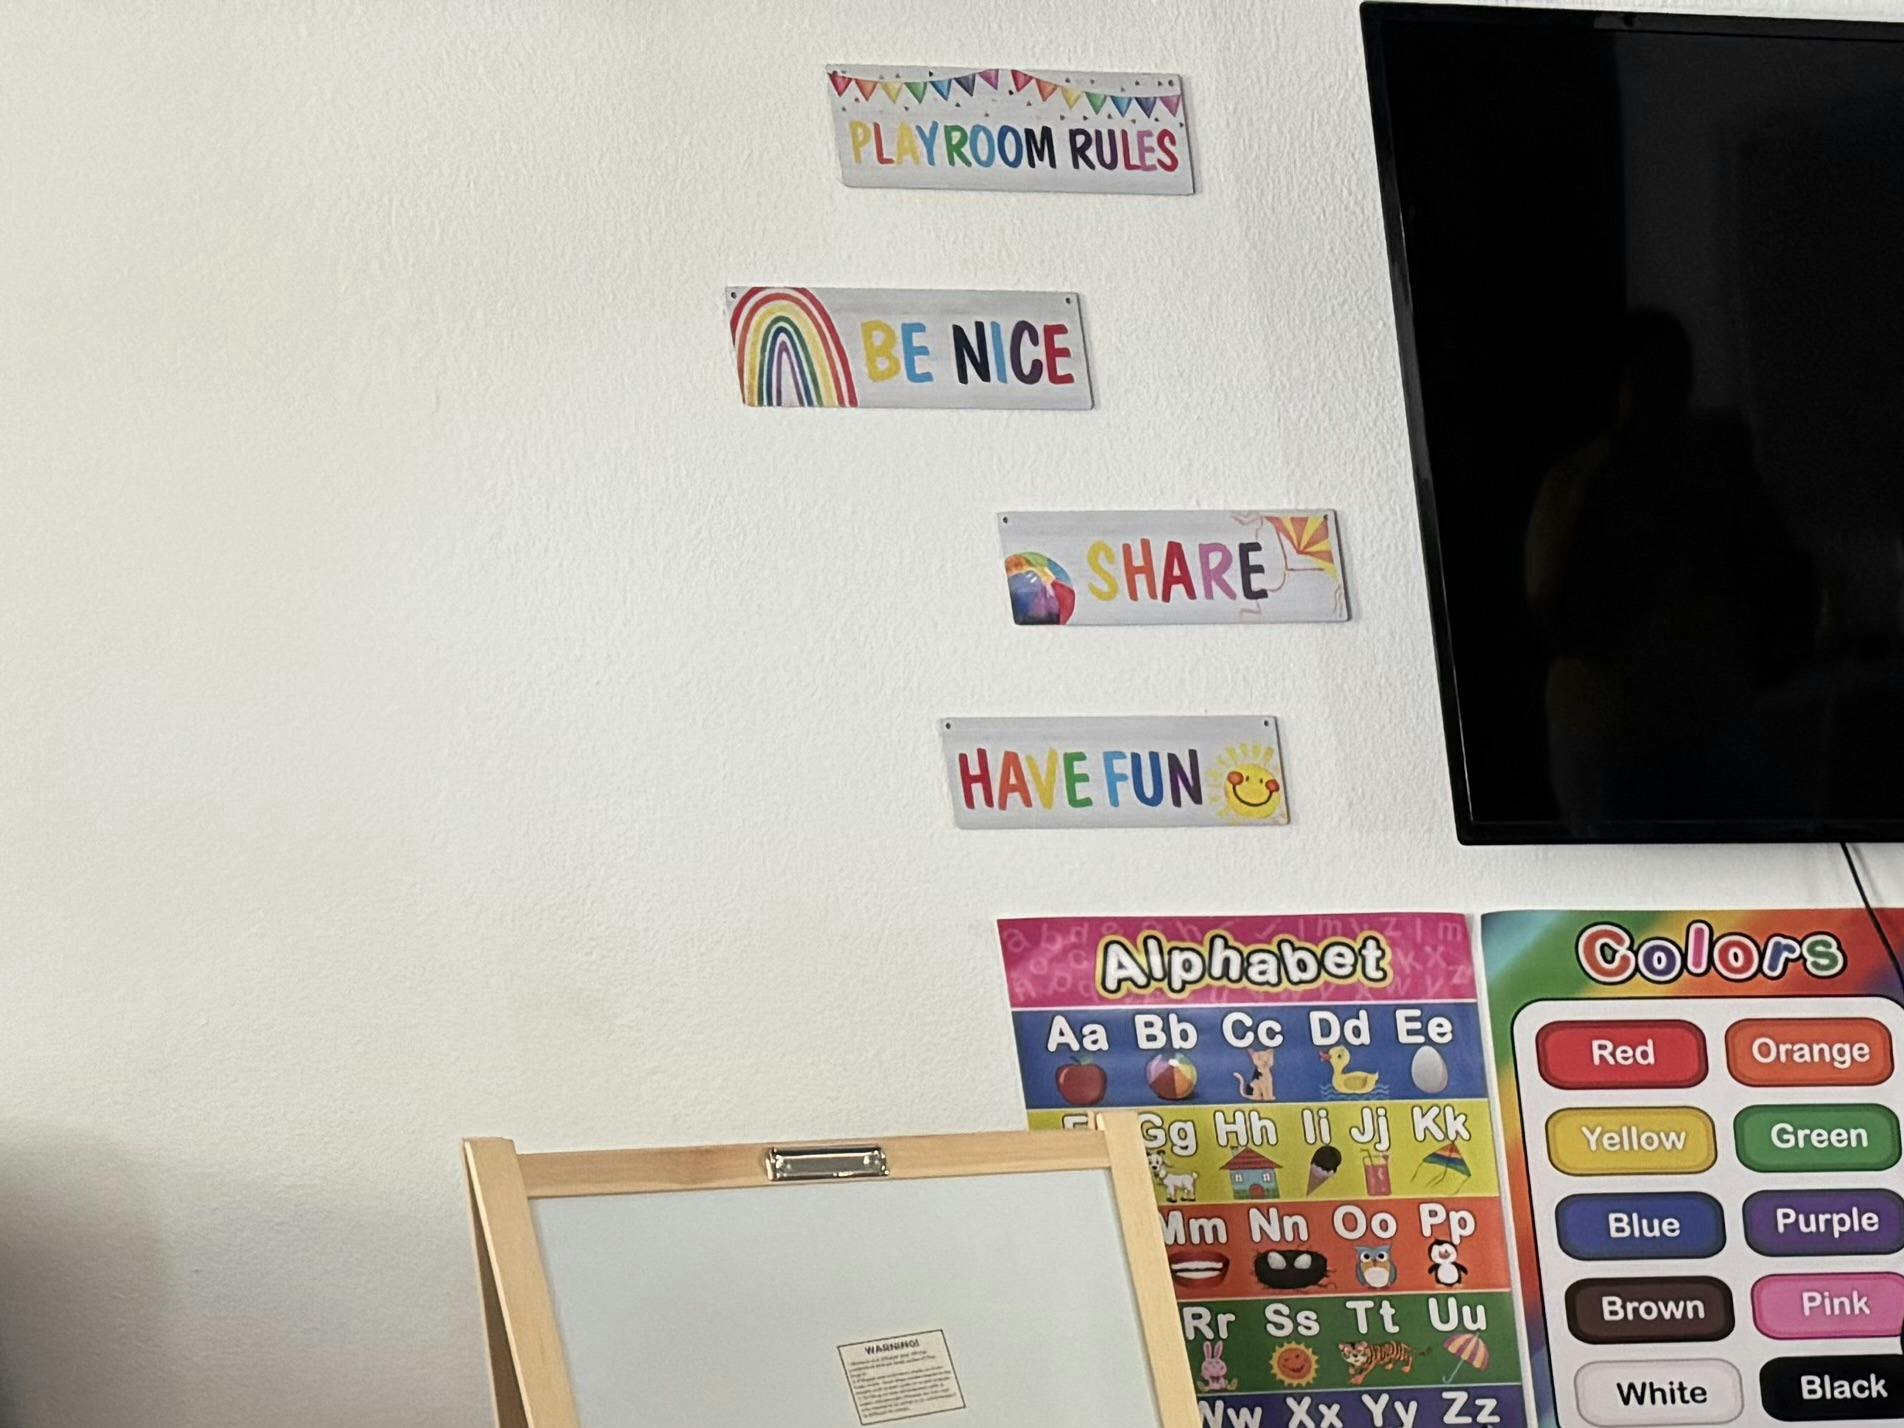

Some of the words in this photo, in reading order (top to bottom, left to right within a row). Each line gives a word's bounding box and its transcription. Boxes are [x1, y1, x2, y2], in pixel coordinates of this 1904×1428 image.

[850, 118, 1054, 172] PLAYROOM
[1071, 122, 1180, 174] RULES
[861, 320, 933, 385] BE
[951, 320, 1074, 387] NICE
[1087, 539, 1268, 603] SHARE
[957, 748, 1092, 813] HAVE
[1103, 748, 1205, 809] FUN
[1100, 934, 1388, 993] Alphabet
[1576, 920, 1847, 985] Colors
[1048, 1015, 1108, 1052] Aa
[1134, 1014, 1198, 1050] Bb
[1222, 1012, 1284, 1047] Cc
[1309, 1010, 1370, 1045] Dd
[1395, 1009, 1453, 1043] Ee
[1592, 1039, 1655, 1067] Red
[1752, 1038, 1870, 1070] Orange
[1139, 1114, 1197, 1157] Gg
[1214, 1111, 1279, 1147] Hh
[1350, 1107, 1390, 1151] Jj
[1411, 1106, 1472, 1142] Kk
[1581, 1126, 1686, 1152] Yellow
[1771, 1124, 1868, 1149] Green
[1249, 1208, 1309, 1243] Nn
[1332, 1205, 1397, 1240] Oo
[1419, 1203, 1475, 1245] Pp
[1608, 1212, 1681, 1239] Blue
[1776, 1207, 1879, 1239] Purple
[1183, 1306, 1236, 1341] Rr
[1264, 1303, 1320, 1337] Ss
[1345, 1301, 1400, 1334] Tt
[1428, 1297, 1487, 1332] Uu
[1602, 1296, 1705, 1322] Brown
[1802, 1291, 1870, 1316] Pink
[1616, 1382, 1707, 1406] White
[1800, 1374, 1888, 1400] Black
[1441, 1391, 1501, 1425] Zz
